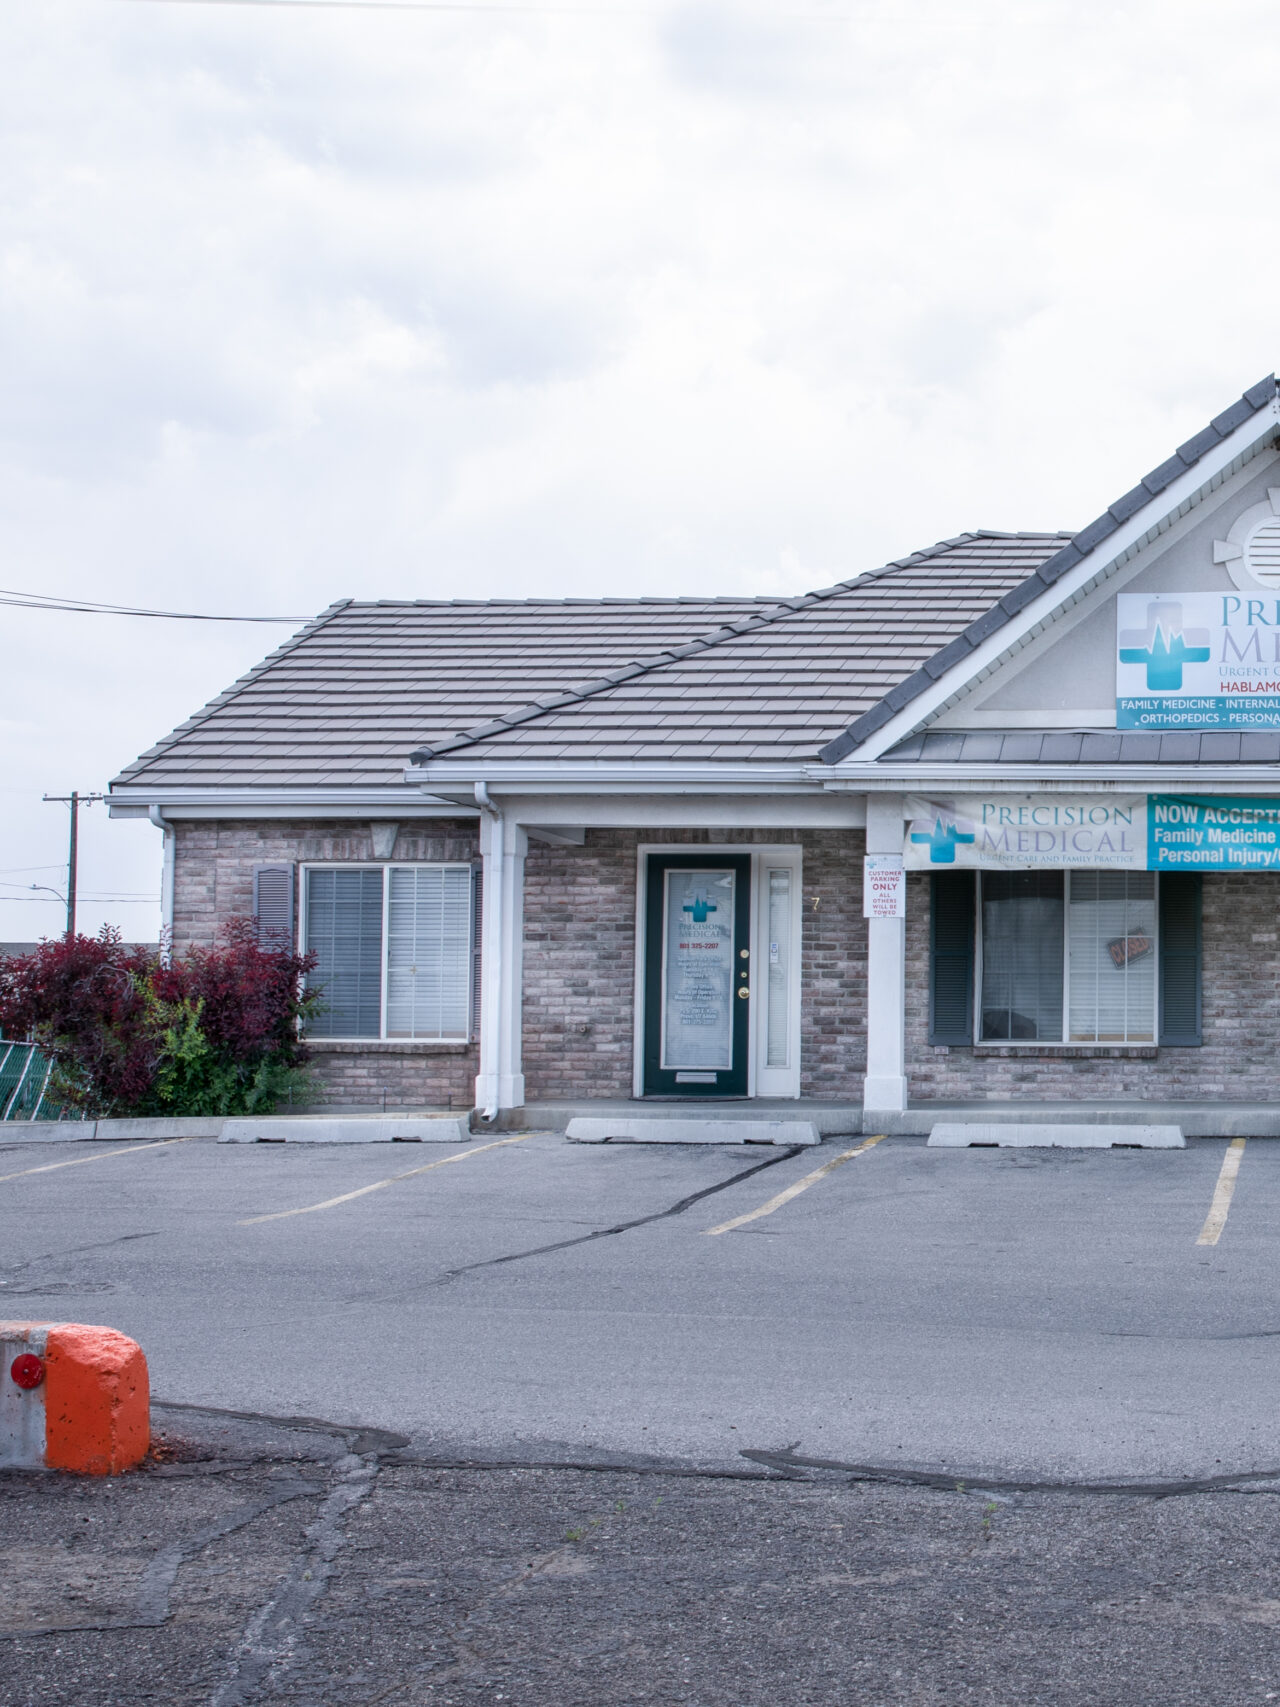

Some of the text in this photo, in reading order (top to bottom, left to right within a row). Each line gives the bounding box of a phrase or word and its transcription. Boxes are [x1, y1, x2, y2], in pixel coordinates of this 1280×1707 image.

[1219, 666, 1269, 677] URGENT
[1121, 700, 1159, 710] FAMILY
[1162, 699, 1216, 709] MEDICINE
[1225, 699, 1280, 709] INTERNAL
[1140, 713, 1220, 723] ORTHOPEDICS
[982, 803, 1133, 826] PRECISION
[1154, 804, 1199, 824] NOW
[981, 826, 1134, 853] MEDICAL
[1154, 828, 1203, 846] Family
[1208, 828, 1276, 844] Medicine
[1041, 855, 1060, 863] AND
[1062, 854, 1091, 863] FAMILY
[1159, 848, 1223, 862] Personal
[872, 883, 898, 891] ONLY
